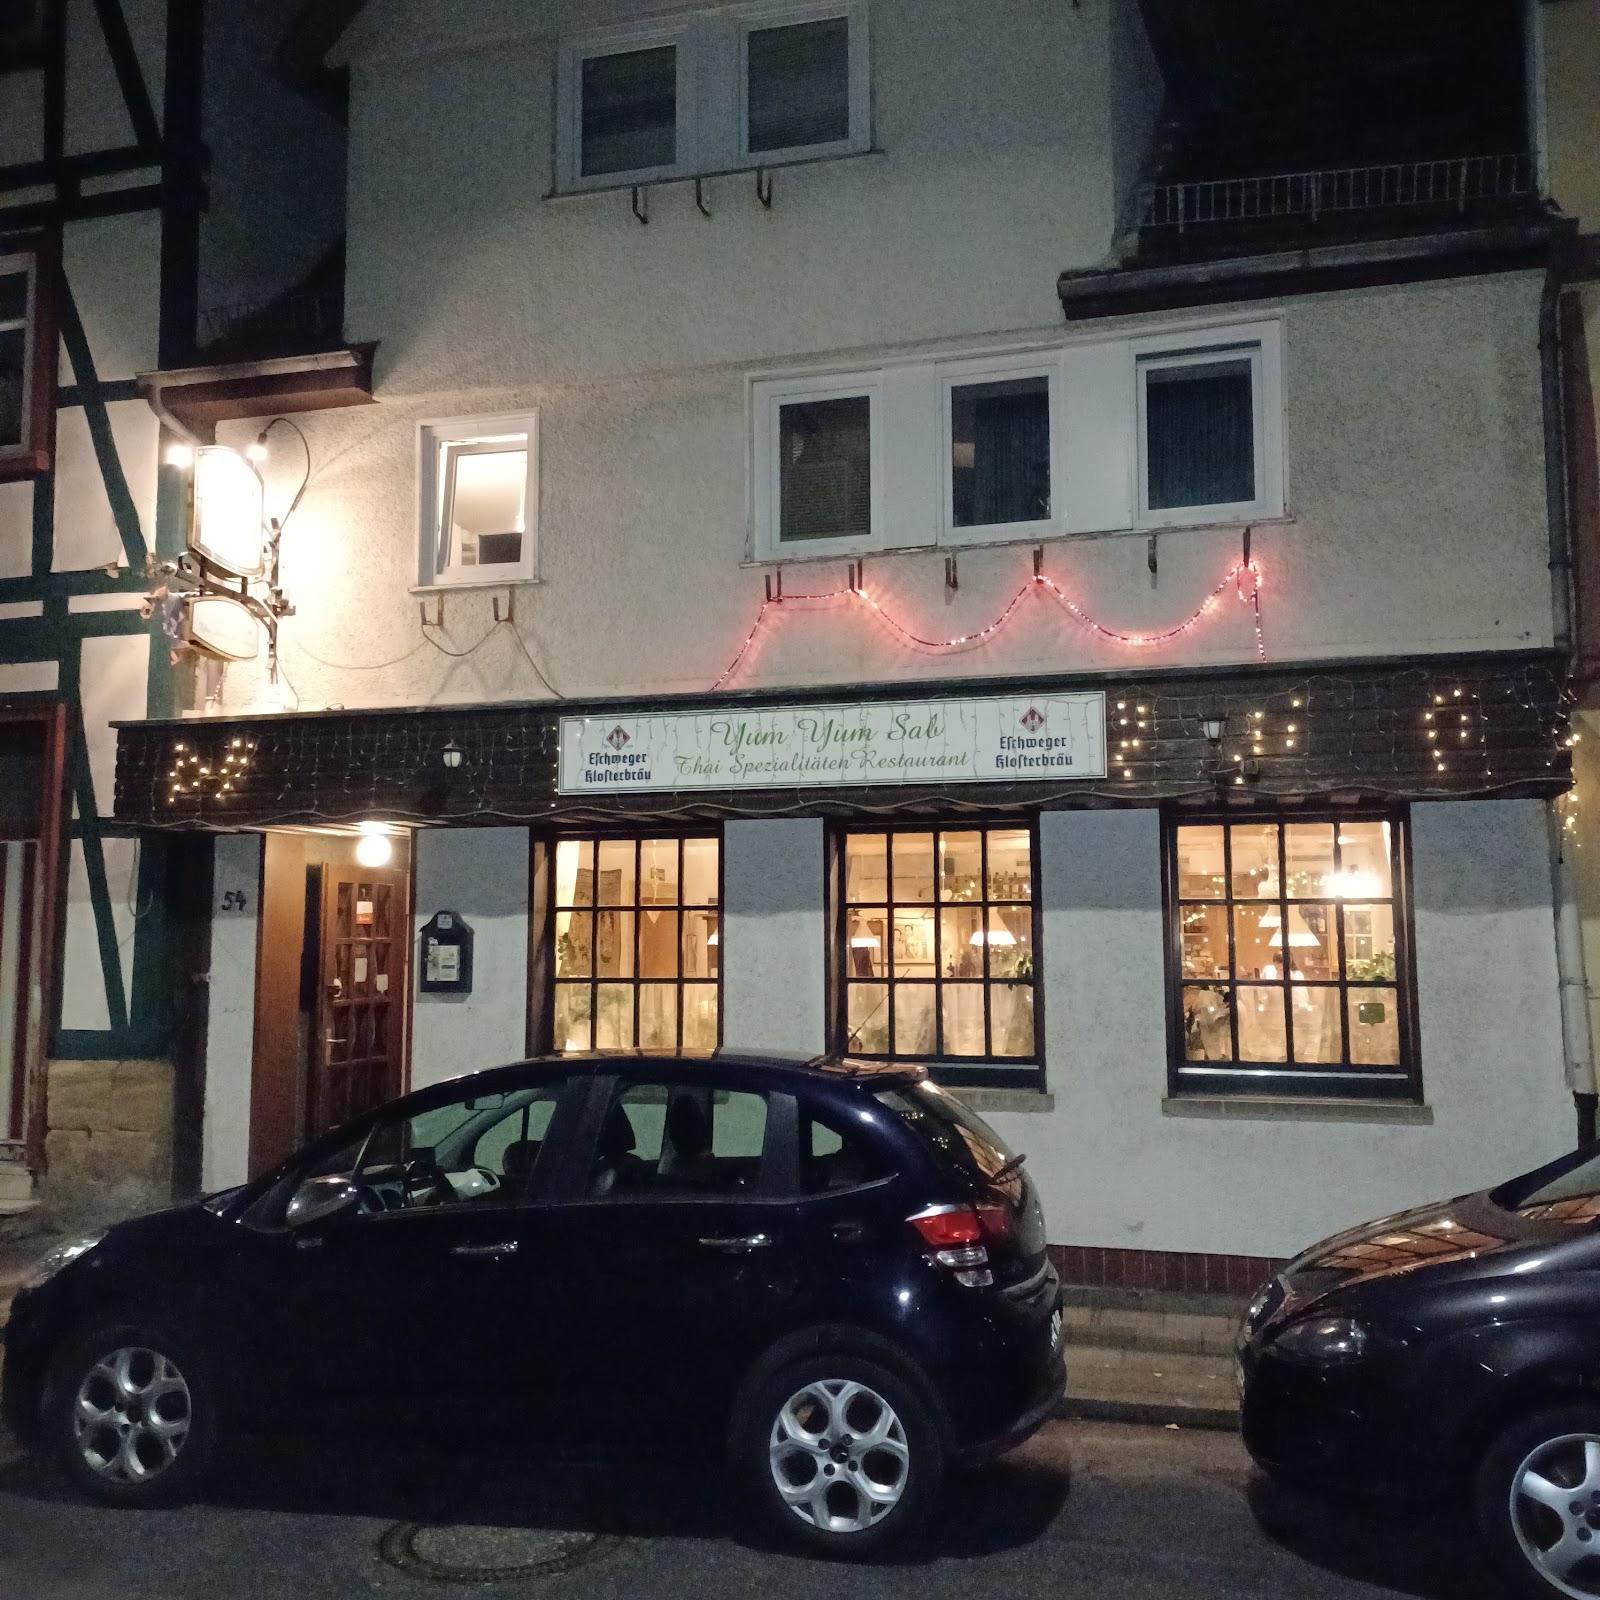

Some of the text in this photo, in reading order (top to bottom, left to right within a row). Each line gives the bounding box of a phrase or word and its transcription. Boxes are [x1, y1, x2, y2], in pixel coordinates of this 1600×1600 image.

[711, 720, 787, 755] Yum
[798, 718, 878, 752] Yum
[675, 750, 968, 779] Thai Spezialitäten Restaurant
[222, 890, 247, 911] 54
